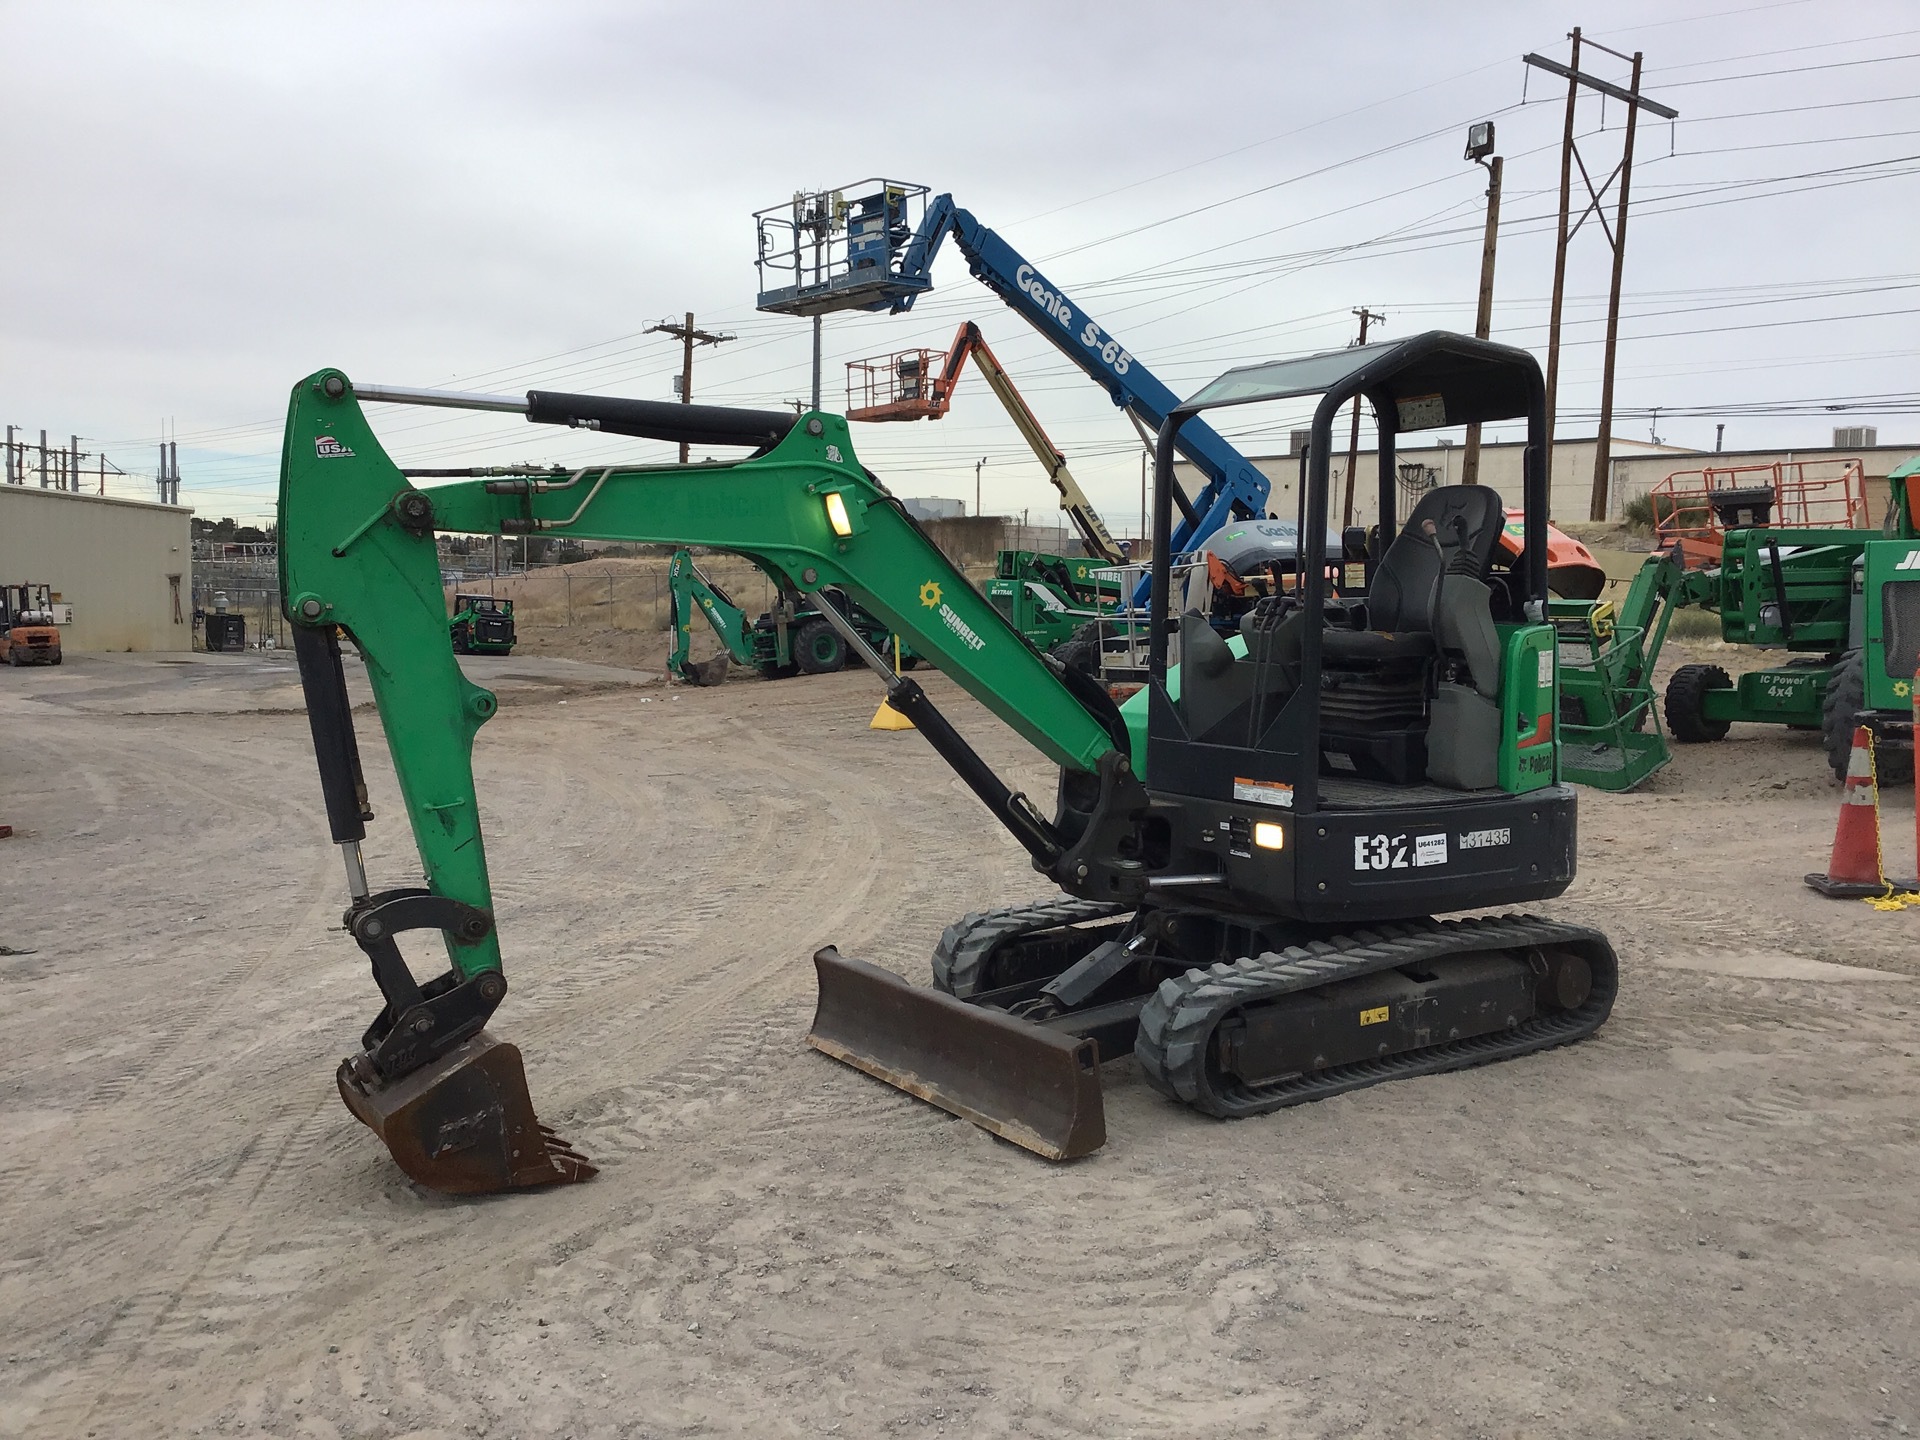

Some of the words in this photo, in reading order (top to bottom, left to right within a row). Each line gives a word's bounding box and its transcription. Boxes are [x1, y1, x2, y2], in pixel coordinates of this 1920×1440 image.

[1016, 264, 1072, 329] Genie
[1081, 322, 1134, 375] S-65
[1082, 504, 1100, 522] JLG
[1257, 524, 1298, 537] Genie
[939, 603, 986, 651] SUNBELT
[942, 618, 974, 650] RENTALS
[1760, 675, 1771, 684] IC
[1773, 676, 1804, 685] Power
[1767, 686, 1794, 697] 4x4
